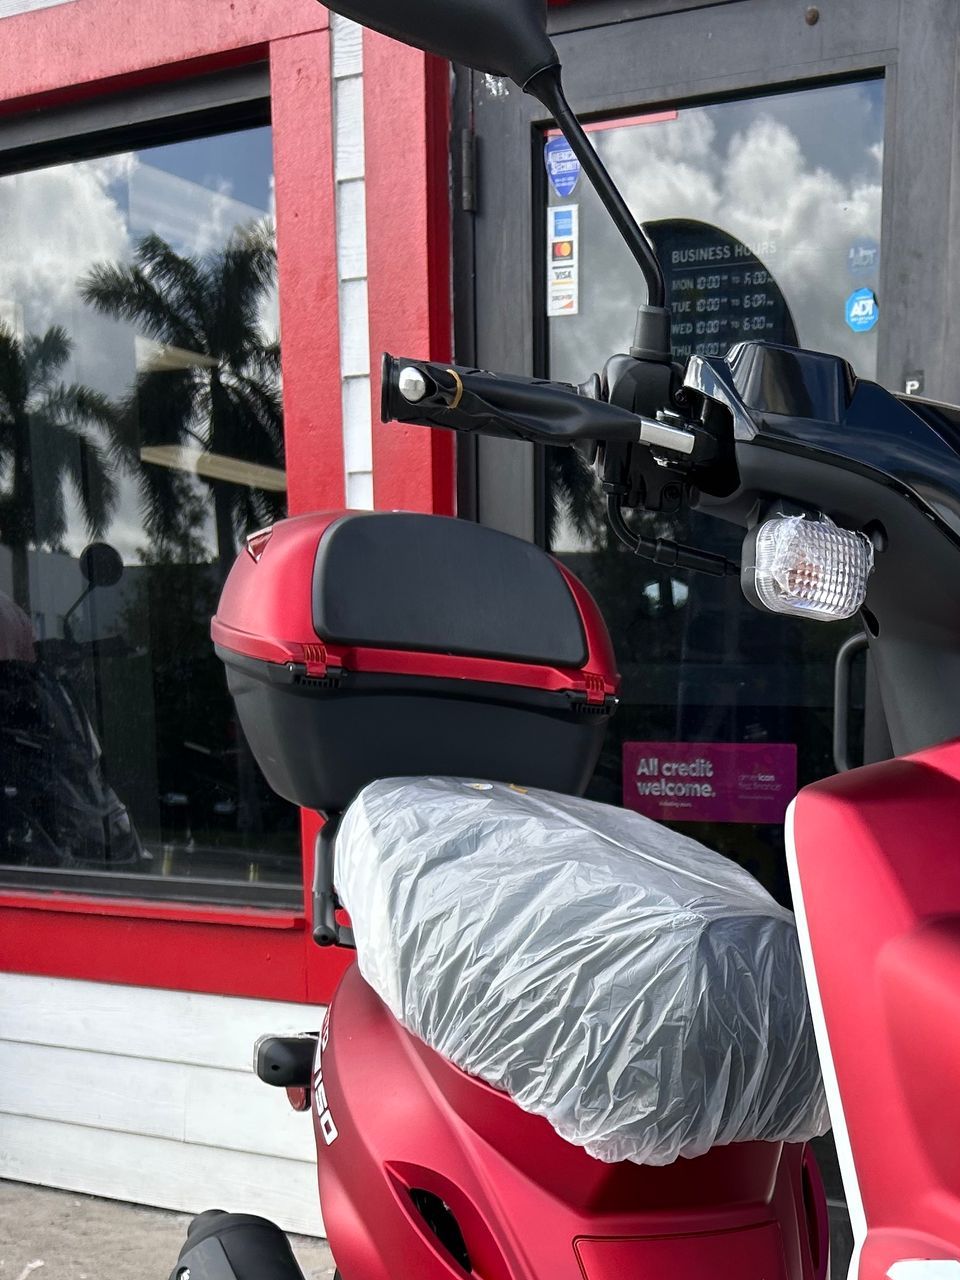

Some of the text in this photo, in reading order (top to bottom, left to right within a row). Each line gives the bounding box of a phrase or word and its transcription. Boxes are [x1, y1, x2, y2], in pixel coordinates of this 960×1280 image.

[672, 246, 731, 264] BUSINESS
[671, 301, 692, 313] TUE
[851, 299, 875, 317] ADT
[671, 323, 693, 335] WED
[637, 758, 714, 777] All credit
[637, 779, 716, 798] welcome.
